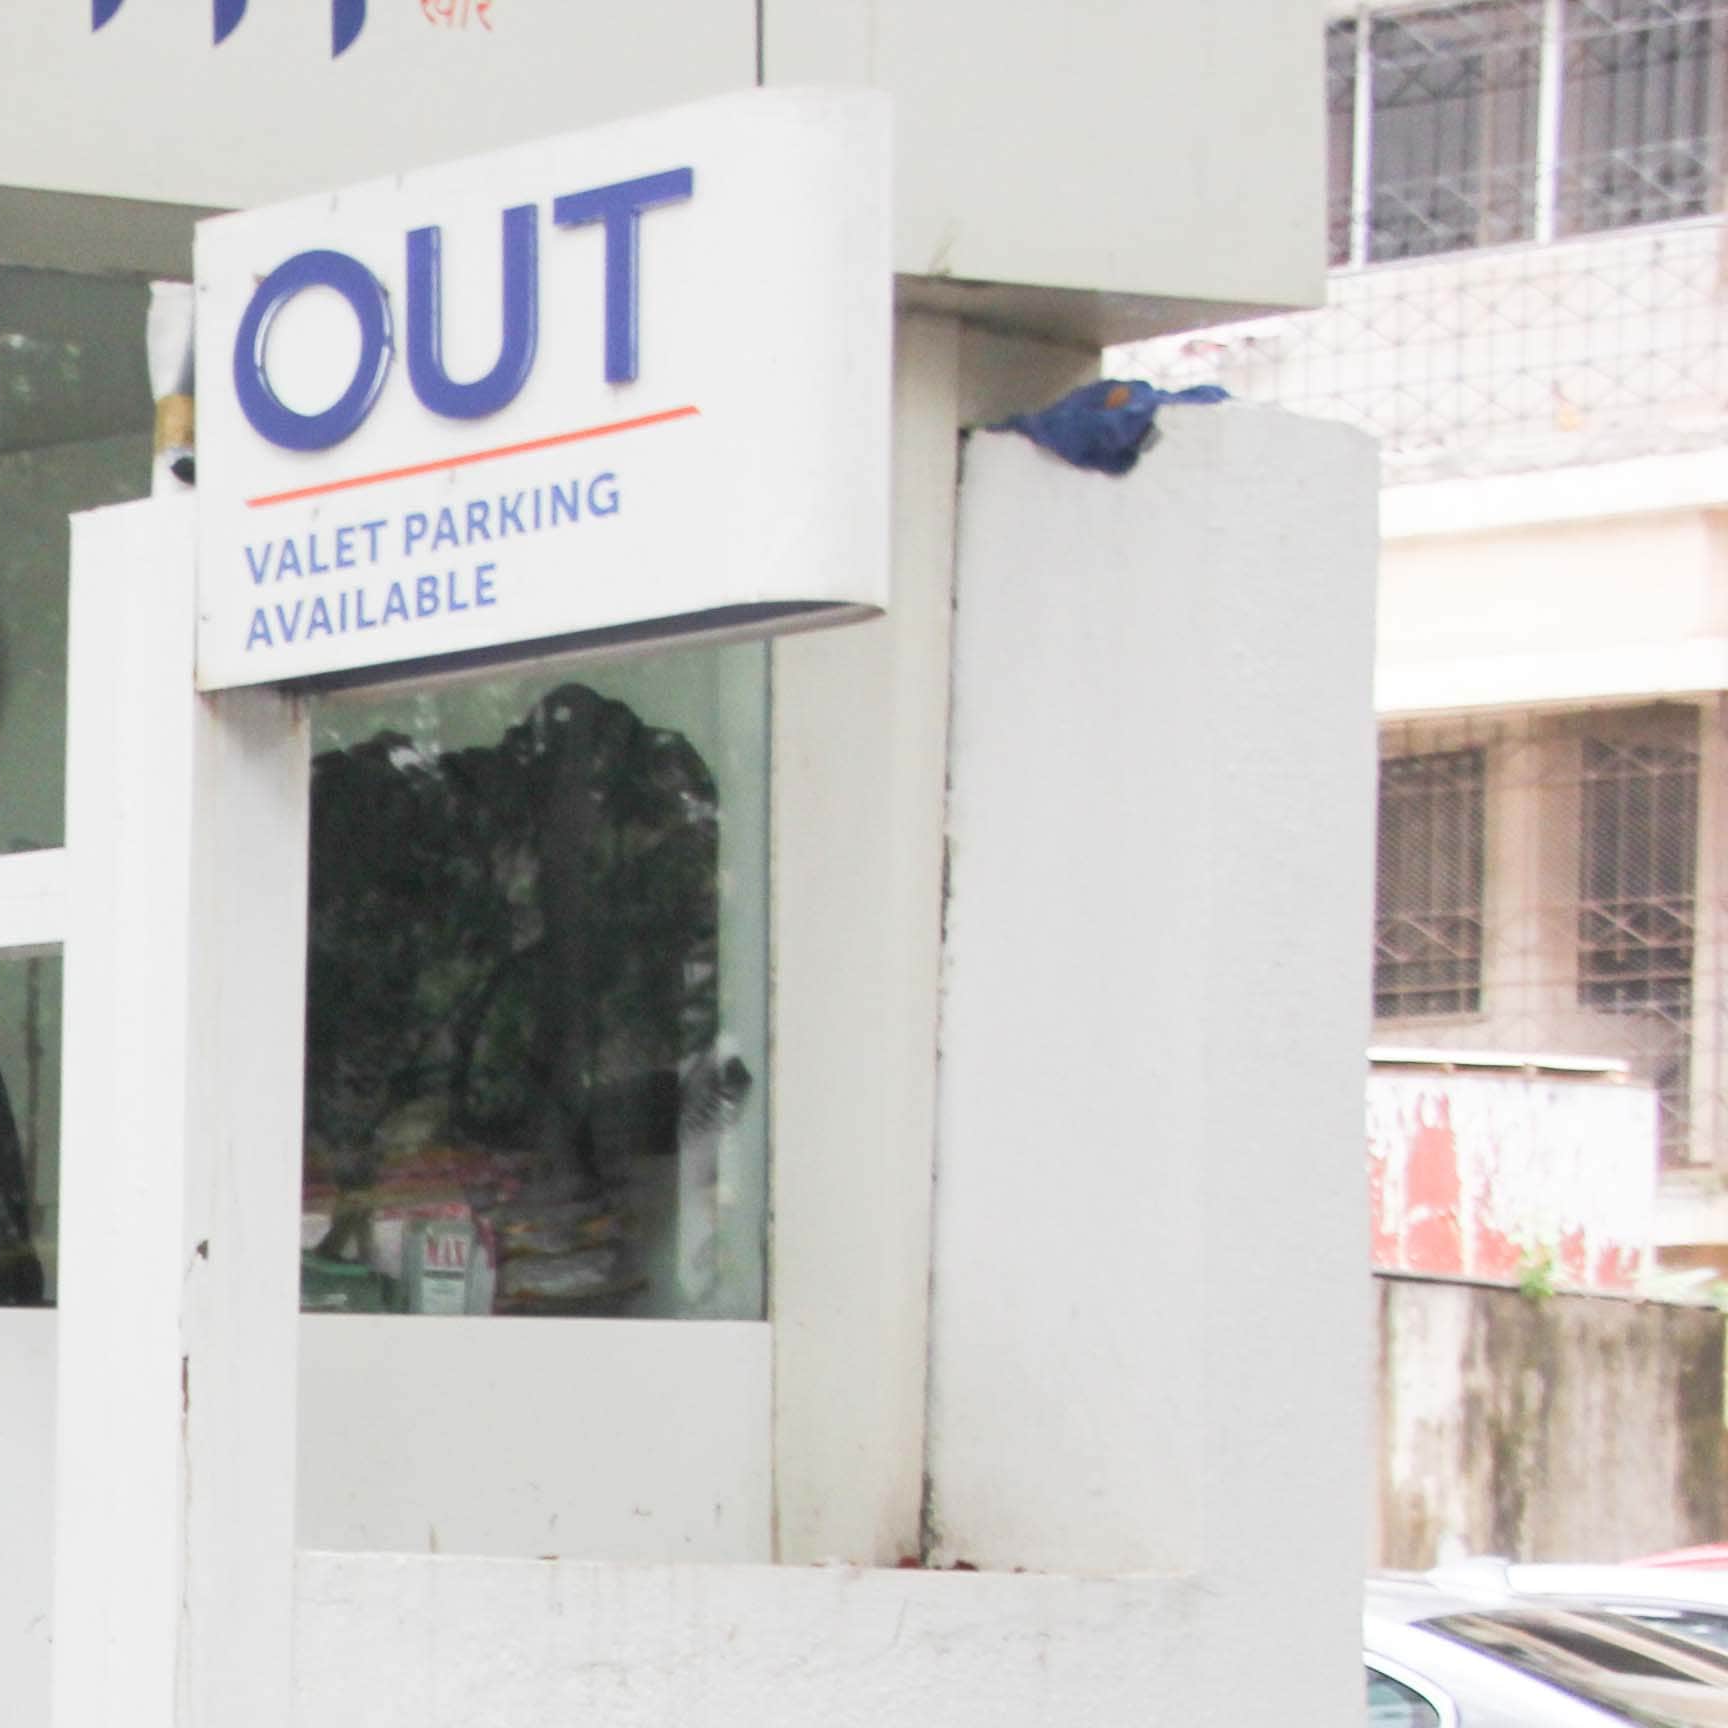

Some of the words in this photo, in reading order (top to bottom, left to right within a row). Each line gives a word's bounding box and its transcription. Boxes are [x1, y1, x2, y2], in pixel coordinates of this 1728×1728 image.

[233, 166, 695, 453] OUT
[245, 518, 388, 586] VALET
[403, 471, 622, 556] PARKING
[245, 562, 497, 652] AVAILABLE
